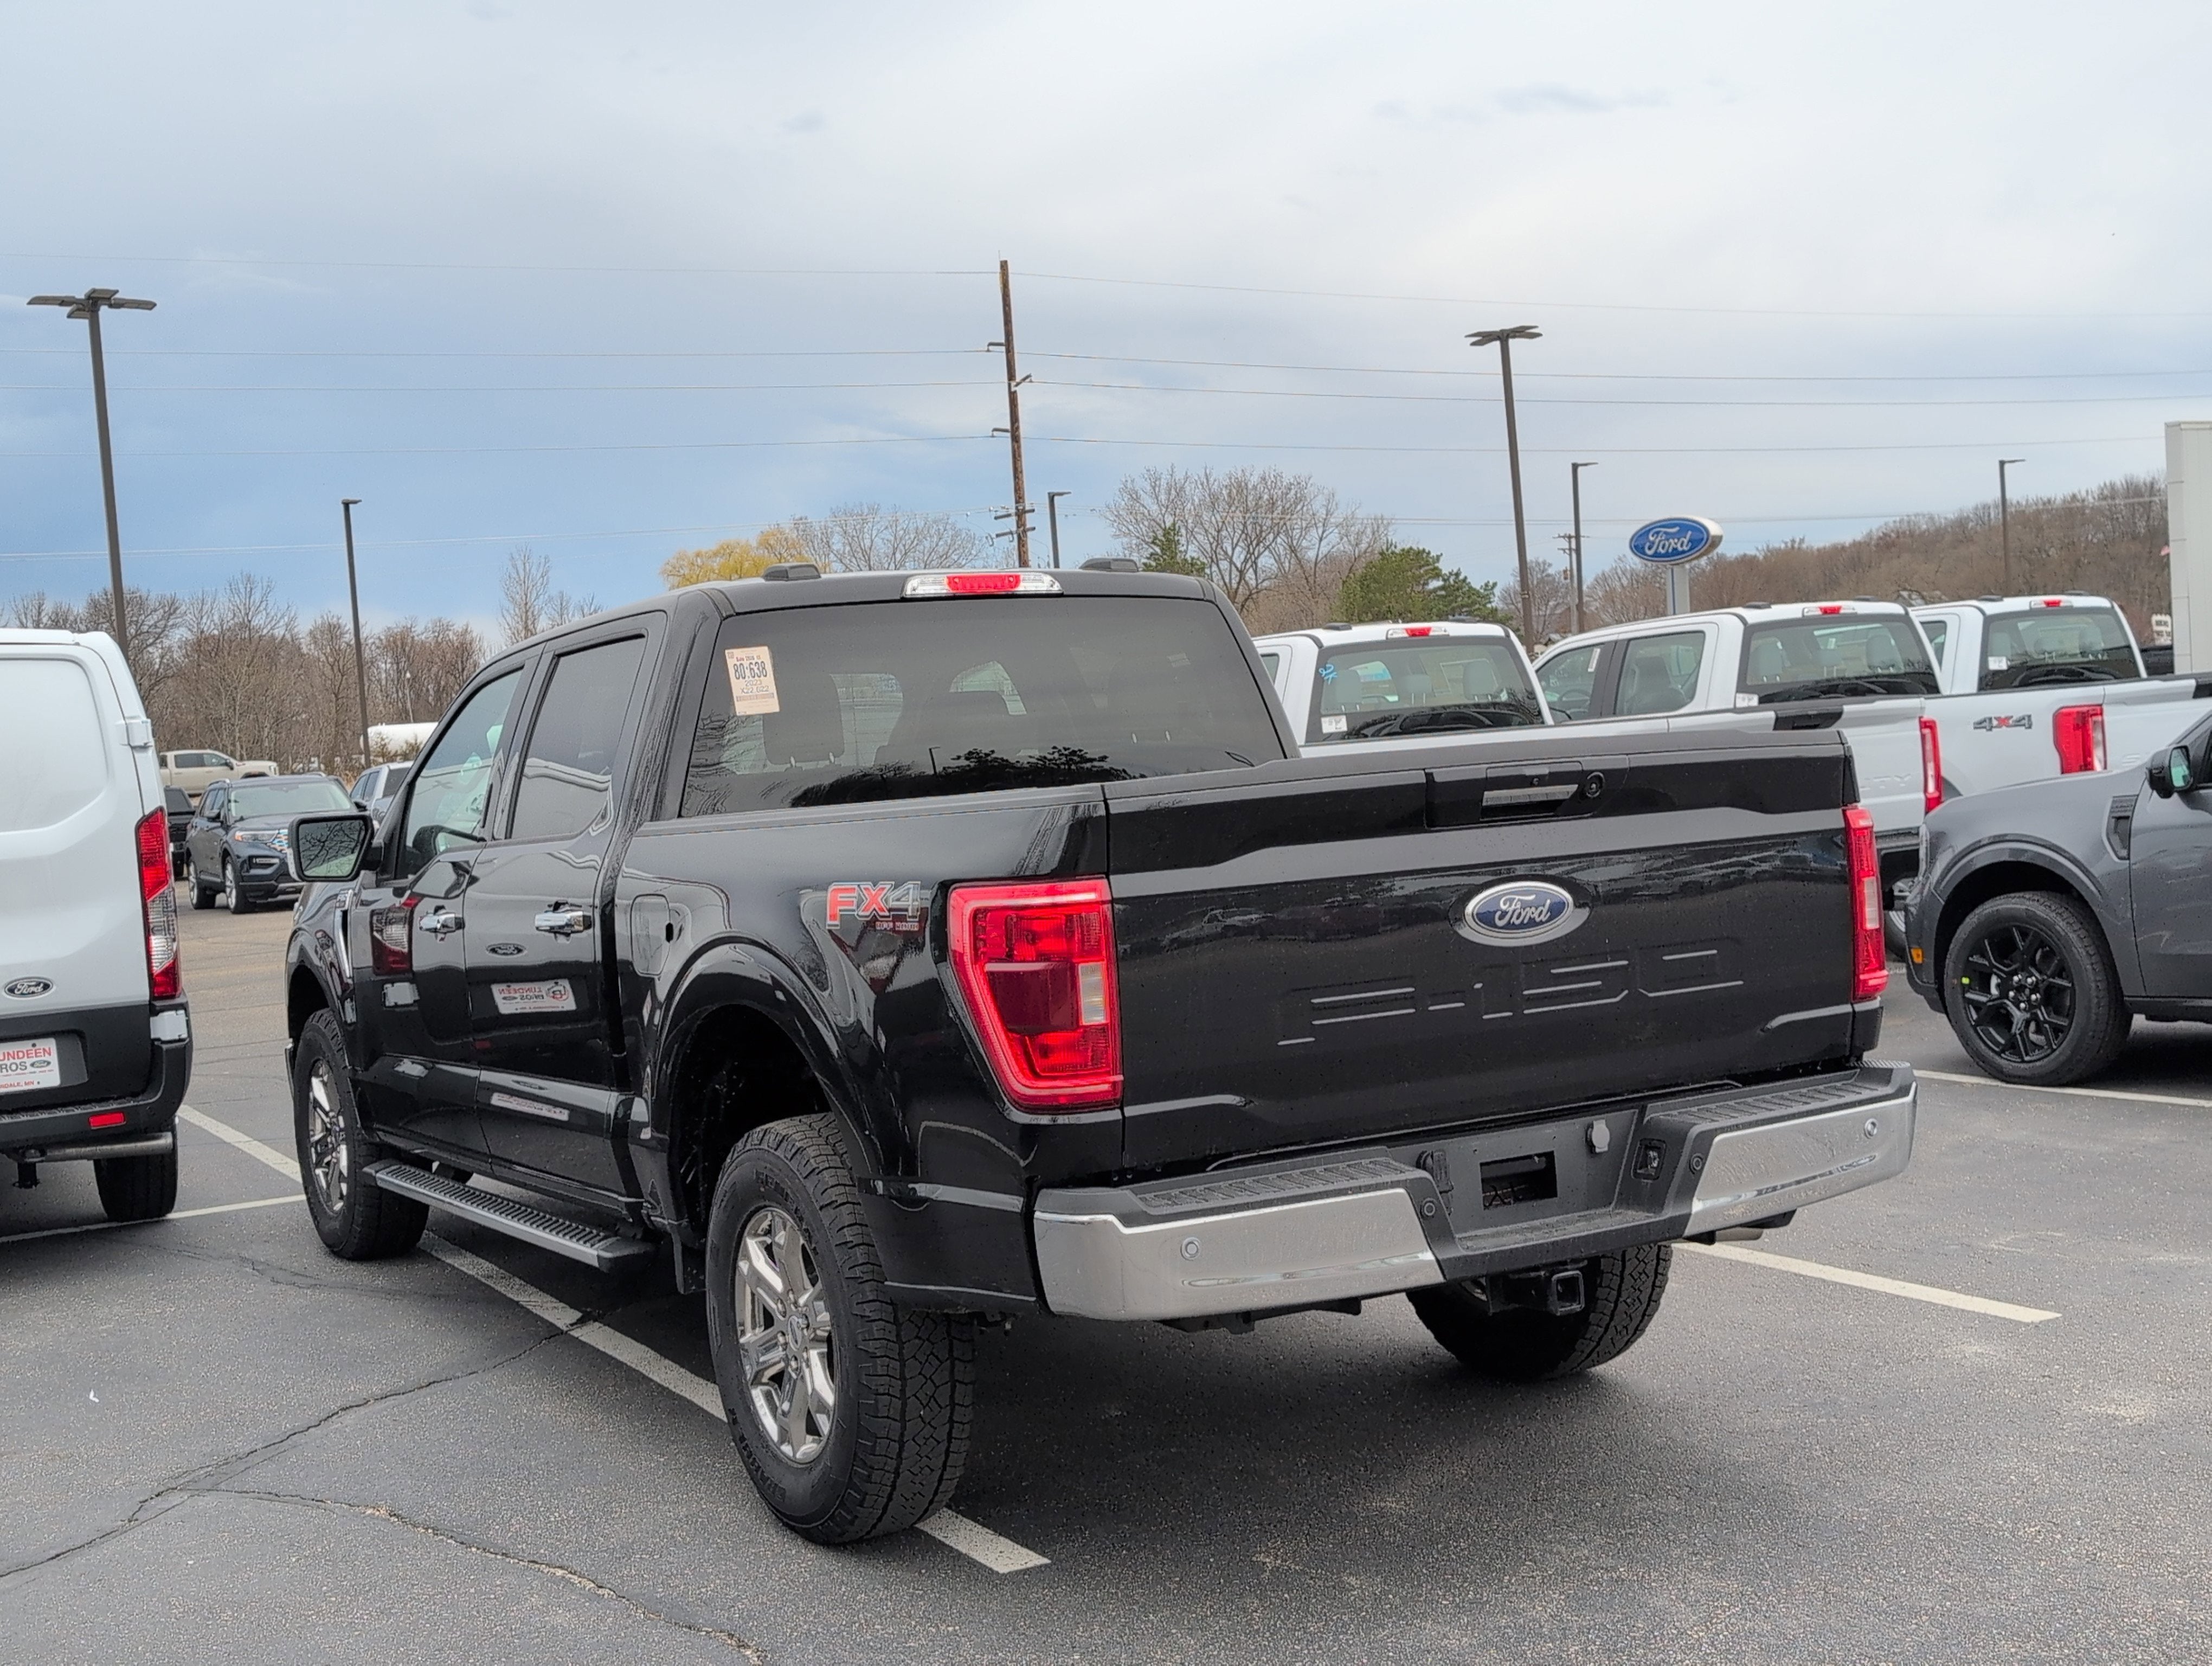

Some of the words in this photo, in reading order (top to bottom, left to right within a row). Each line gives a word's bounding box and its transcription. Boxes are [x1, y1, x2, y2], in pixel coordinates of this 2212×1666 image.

[1645, 526, 1692, 555] Ford
[826, 881, 921, 930] FX4
[1495, 894, 1551, 927] Ford
[14, 981, 43, 994] Ford
[1276, 937, 1746, 1047] F-150
